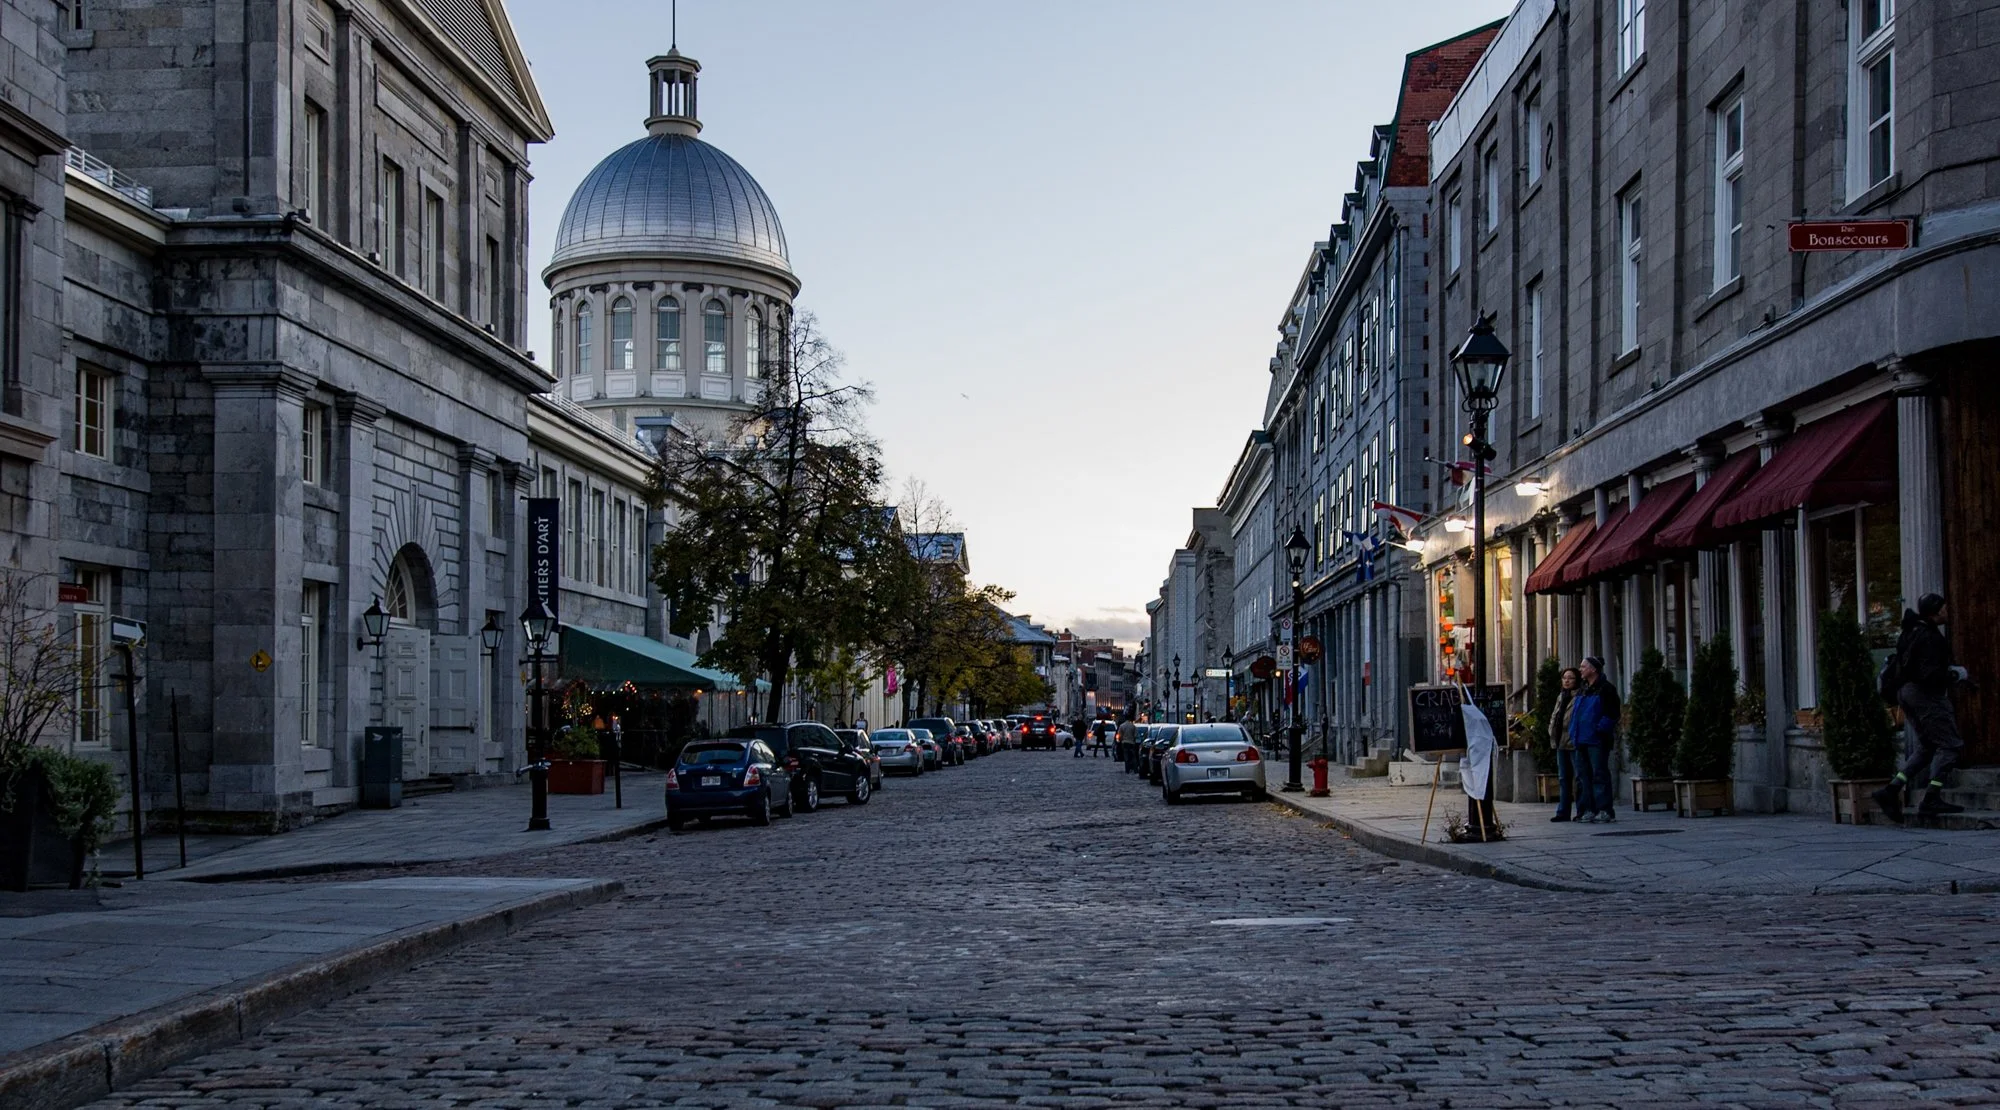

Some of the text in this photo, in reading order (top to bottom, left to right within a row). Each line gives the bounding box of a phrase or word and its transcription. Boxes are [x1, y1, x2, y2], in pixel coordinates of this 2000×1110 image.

[1808, 233, 1889, 246] Bonsecours
[536, 516, 549, 605] TIERS D'ART
